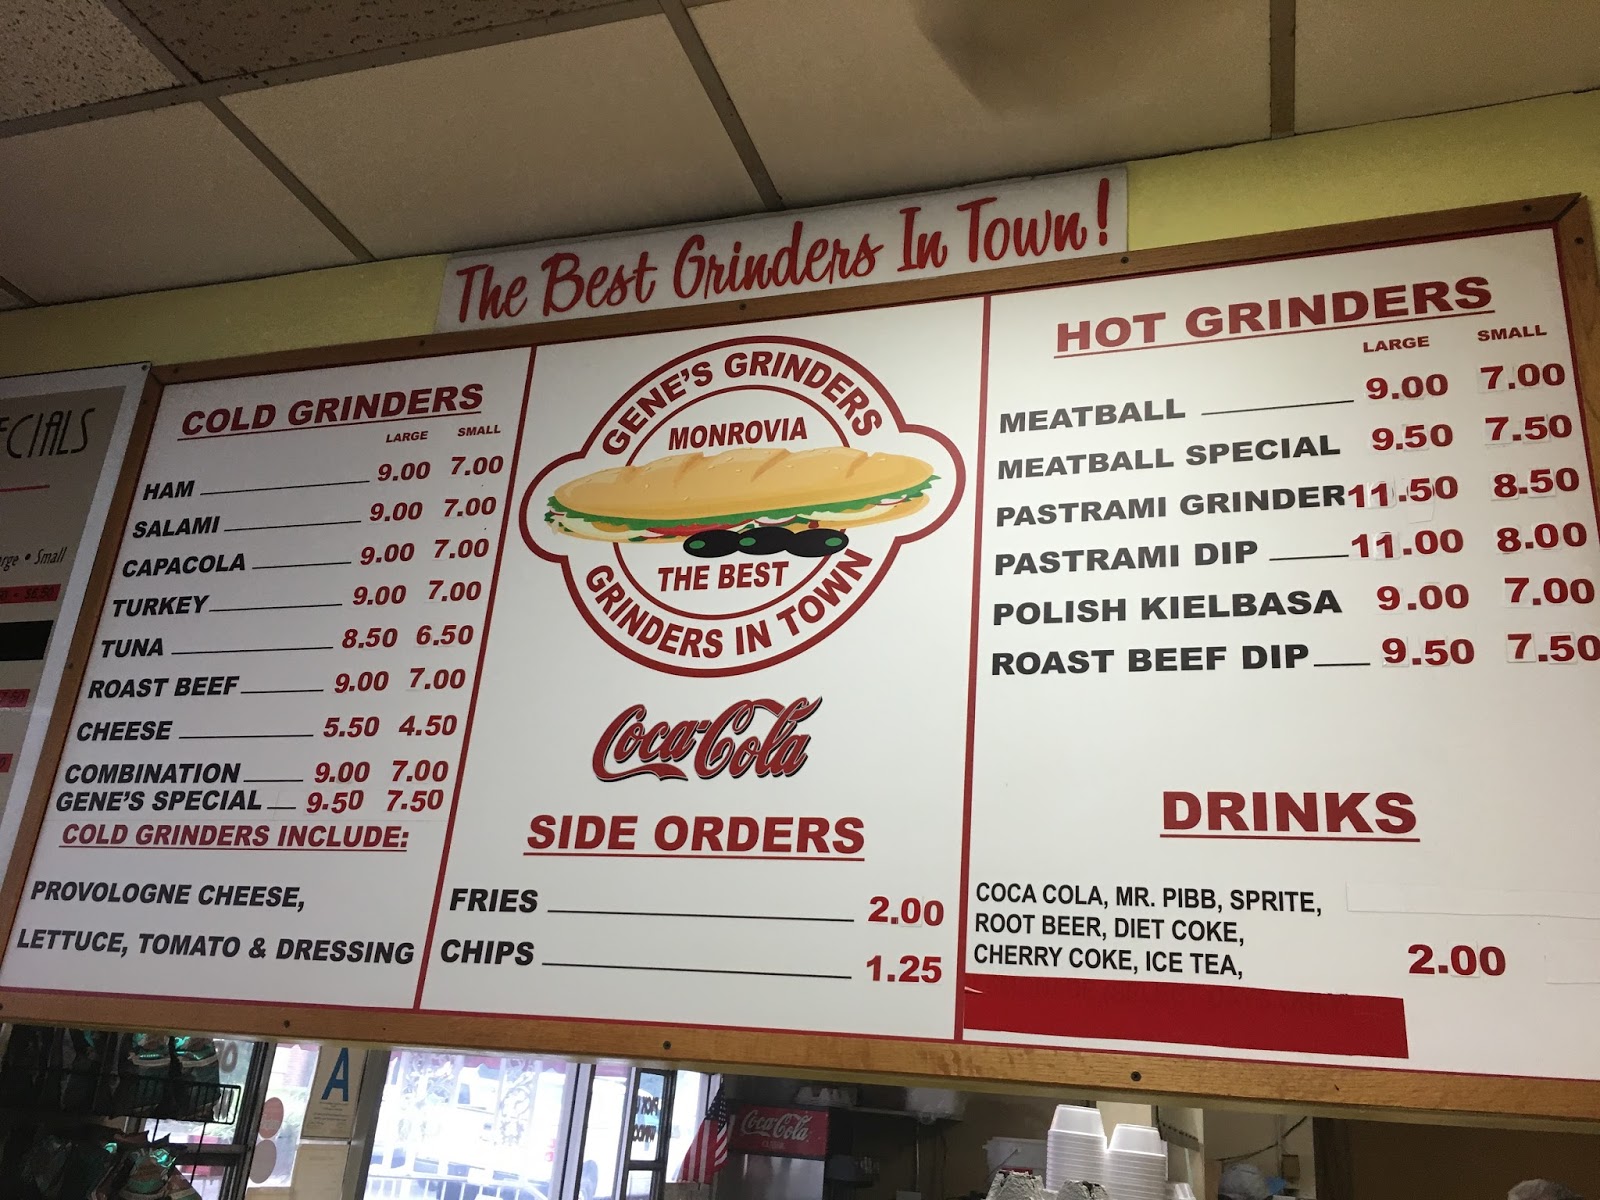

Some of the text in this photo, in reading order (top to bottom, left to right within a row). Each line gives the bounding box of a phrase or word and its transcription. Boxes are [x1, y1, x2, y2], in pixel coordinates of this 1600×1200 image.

[456, 178, 1110, 323] The Best Grinders In Town!
[1058, 278, 1492, 352] HOT GRINDERS
[1363, 325, 1547, 352] LARGE SMALL
[182, 384, 483, 435] COLD GRINDERS
[602, 351, 883, 455] GENE'S GRINDERS
[1000, 363, 1565, 433] MEATBALL 9.00 7.00
[386, 425, 501, 443] LARGE SMALL
[669, 417, 807, 450] MONROVIA
[998, 415, 1572, 479] MEATBALL SPECIAL 9.50 7.50
[143, 456, 503, 500] HAM 9.00 7.00
[997, 468, 1579, 527] PASTRAMI GRINDER 11.50 8.50
[133, 497, 496, 538] SALAMI 9.00 7.00
[34, 547, 67, 565] Small
[123, 539, 489, 577] CAPACOLA 9.00 7.00
[995, 522, 1587, 575] PASTRAMI DIP 11.00 8.00
[658, 561, 789, 591] THE BEST
[113, 580, 481, 617] TURKEY 9.00 7.00
[586, 548, 873, 658] GRINDERS IN TOWN
[994, 578, 1594, 625] POLISH KIELBASA 9.00 7.00
[102, 625, 473, 658] TUNA 8.50 6.50
[992, 634, 1600, 675] ROAST BEEF DIP 9.50 7.50
[88, 668, 465, 698] ROAST BEEF 9.00 7.00
[77, 715, 457, 741] CHEESE 5.50 4.50
[592, 696, 822, 782] Coca-Cola
[65, 760, 448, 784] COMBINATION 9.00 7.00
[56, 790, 443, 813] GENE'S SPECIAL 9.50 7.50
[1164, 792, 1416, 834] DRINKS
[63, 824, 409, 847] COLD GRINDERS INCLUDE:
[528, 815, 864, 854] SIDE ORDERS
[31, 881, 304, 912] PROVOLOGNE CHEESE,
[450, 888, 944, 926] FRIES 2.00
[977, 883, 1321, 916] COCA COLA, MR. PIBB, SPRITE,
[17, 929, 414, 964] LETTUCE, TOMATO & DRESSING
[976, 913, 1243, 946] ROOT BEER, DIET COKE,
[441, 939, 941, 983] CHIPS 1.25
[974, 944, 1242, 980] CHERRY COKE, ICE TEA,
[1408, 944, 1505, 976] 2.00
[321, 1048, 349, 1102] A
[739, 1109, 812, 1141] Coca-Cola
